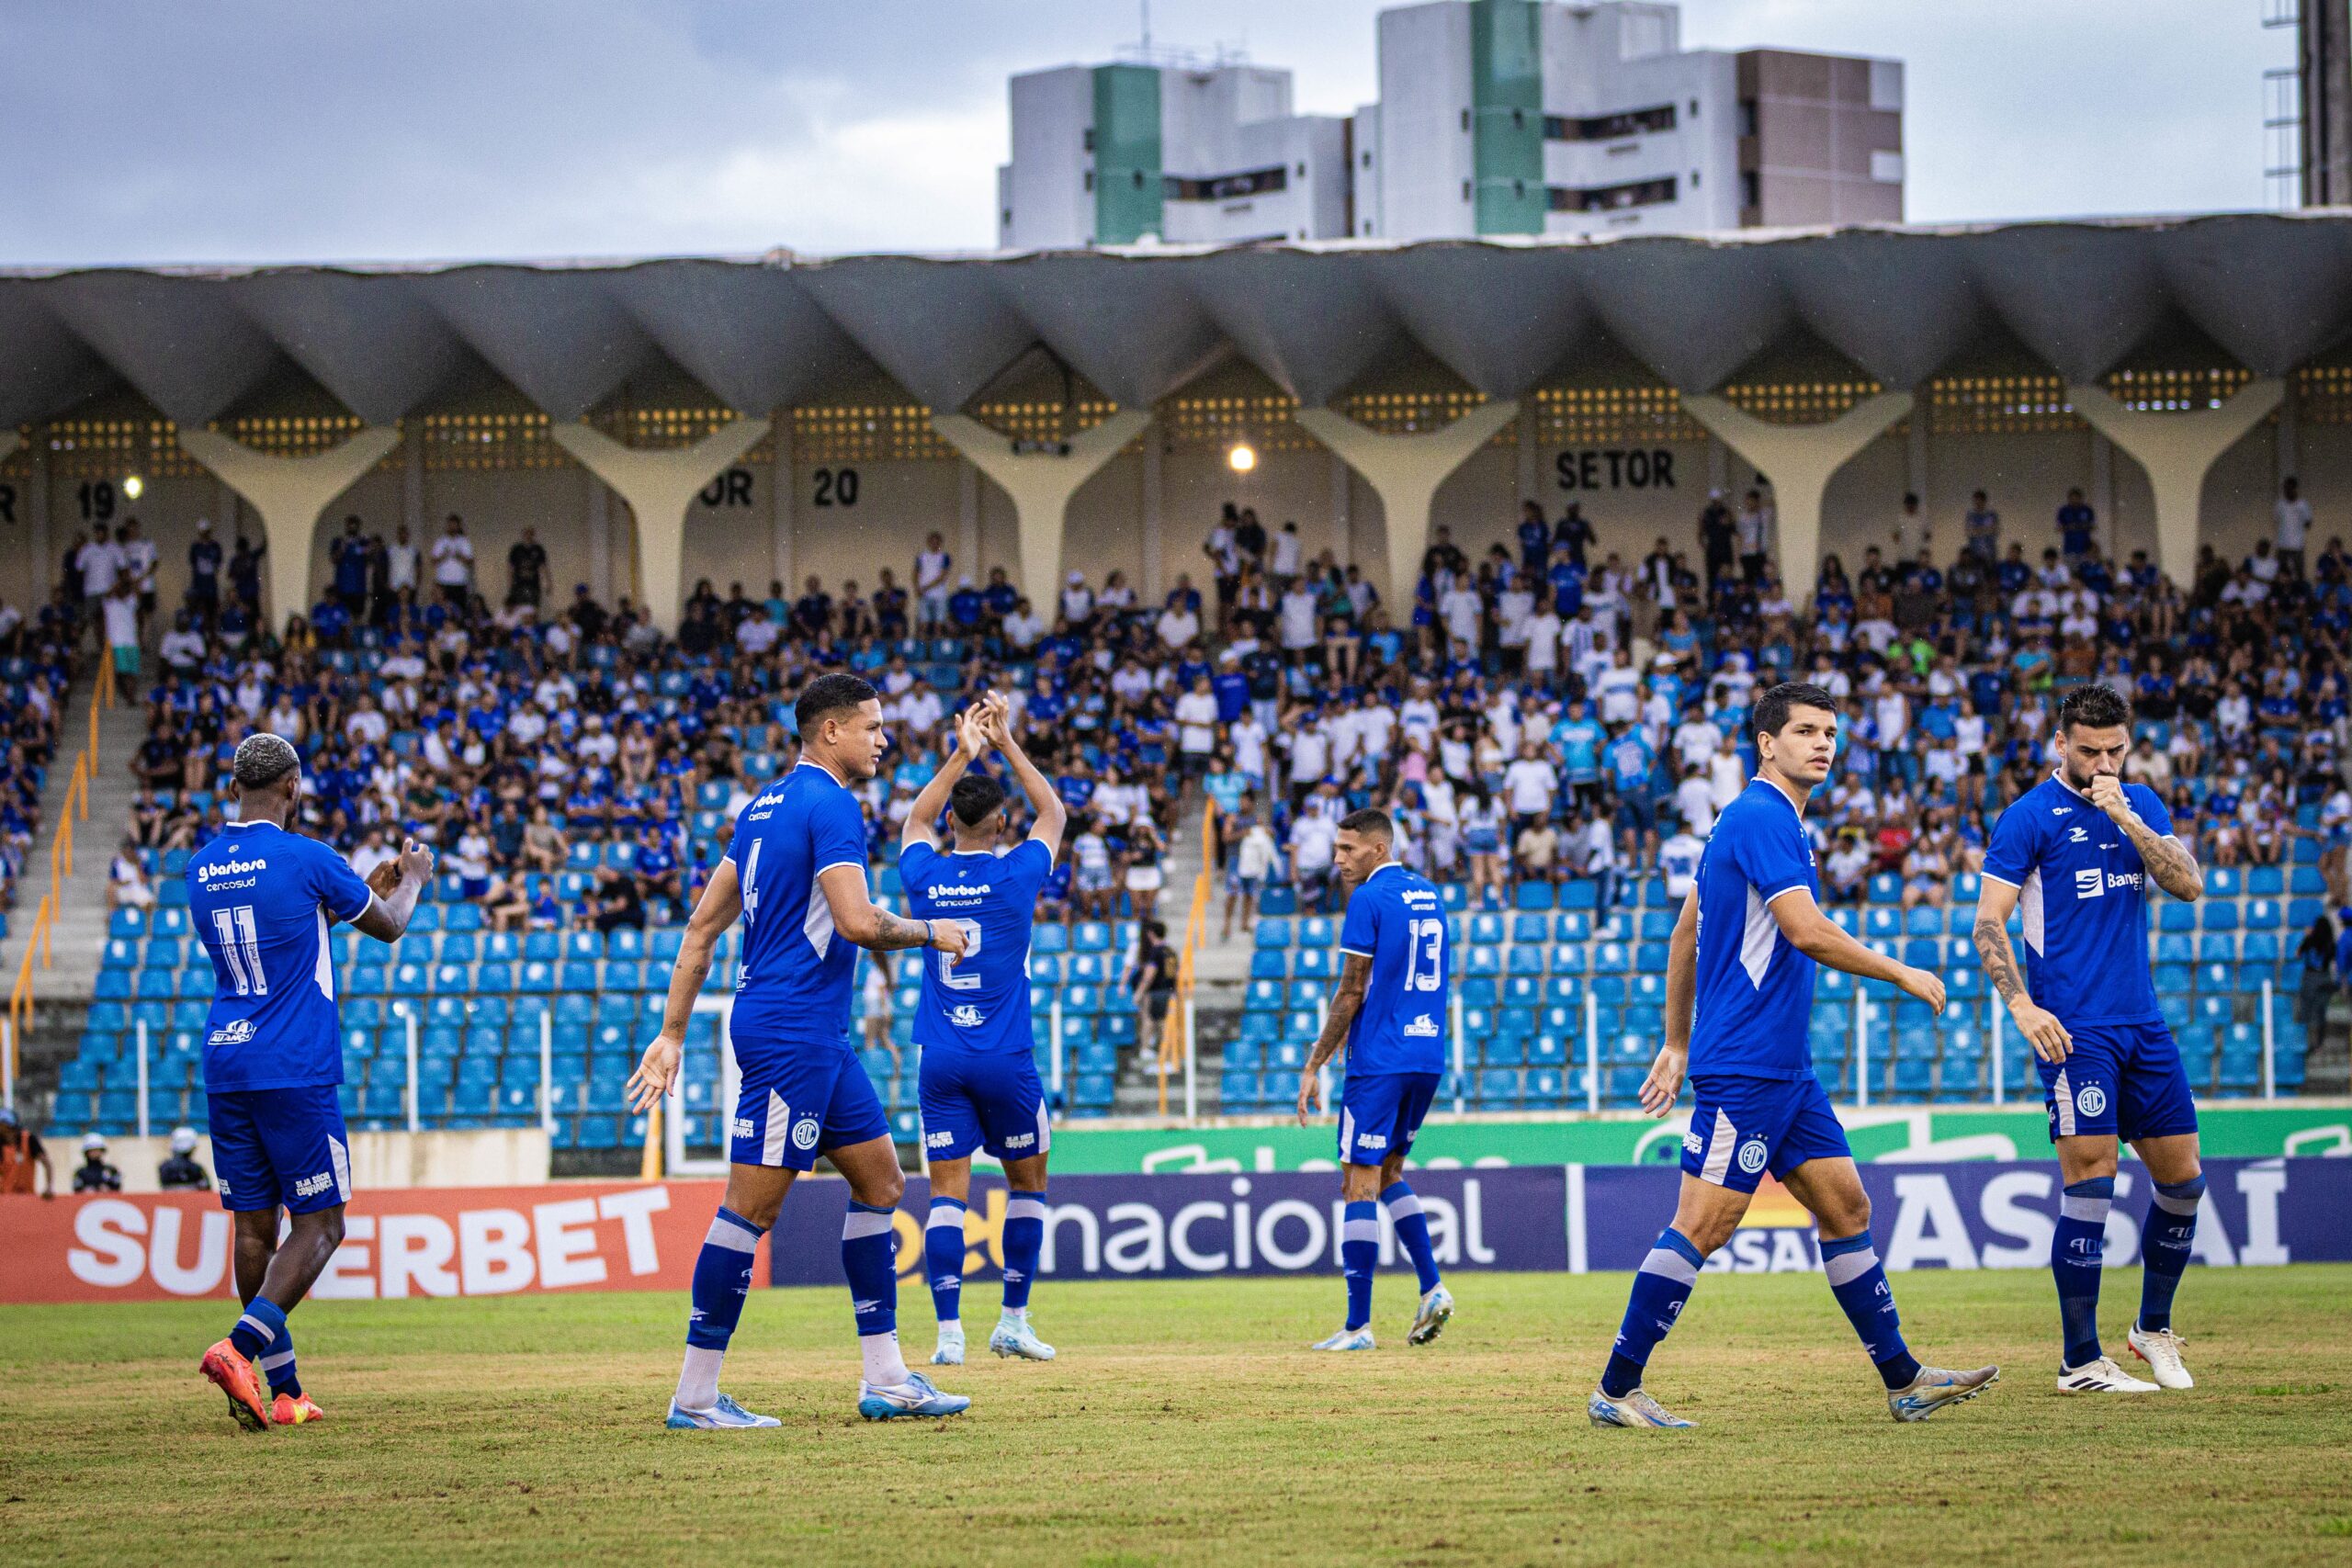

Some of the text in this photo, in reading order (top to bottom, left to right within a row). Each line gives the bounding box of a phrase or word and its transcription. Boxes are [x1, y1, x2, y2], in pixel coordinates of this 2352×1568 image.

[813, 468, 859, 506] 20
[1556, 449, 1677, 490] SETOR
[79, 480, 116, 519] 19
[206, 875, 256, 892] cencosud
[935, 897, 983, 908] cencosud
[211, 905, 268, 996] 11
[1404, 918, 1443, 992] 13
[67, 1187, 671, 1299] SUERBET
